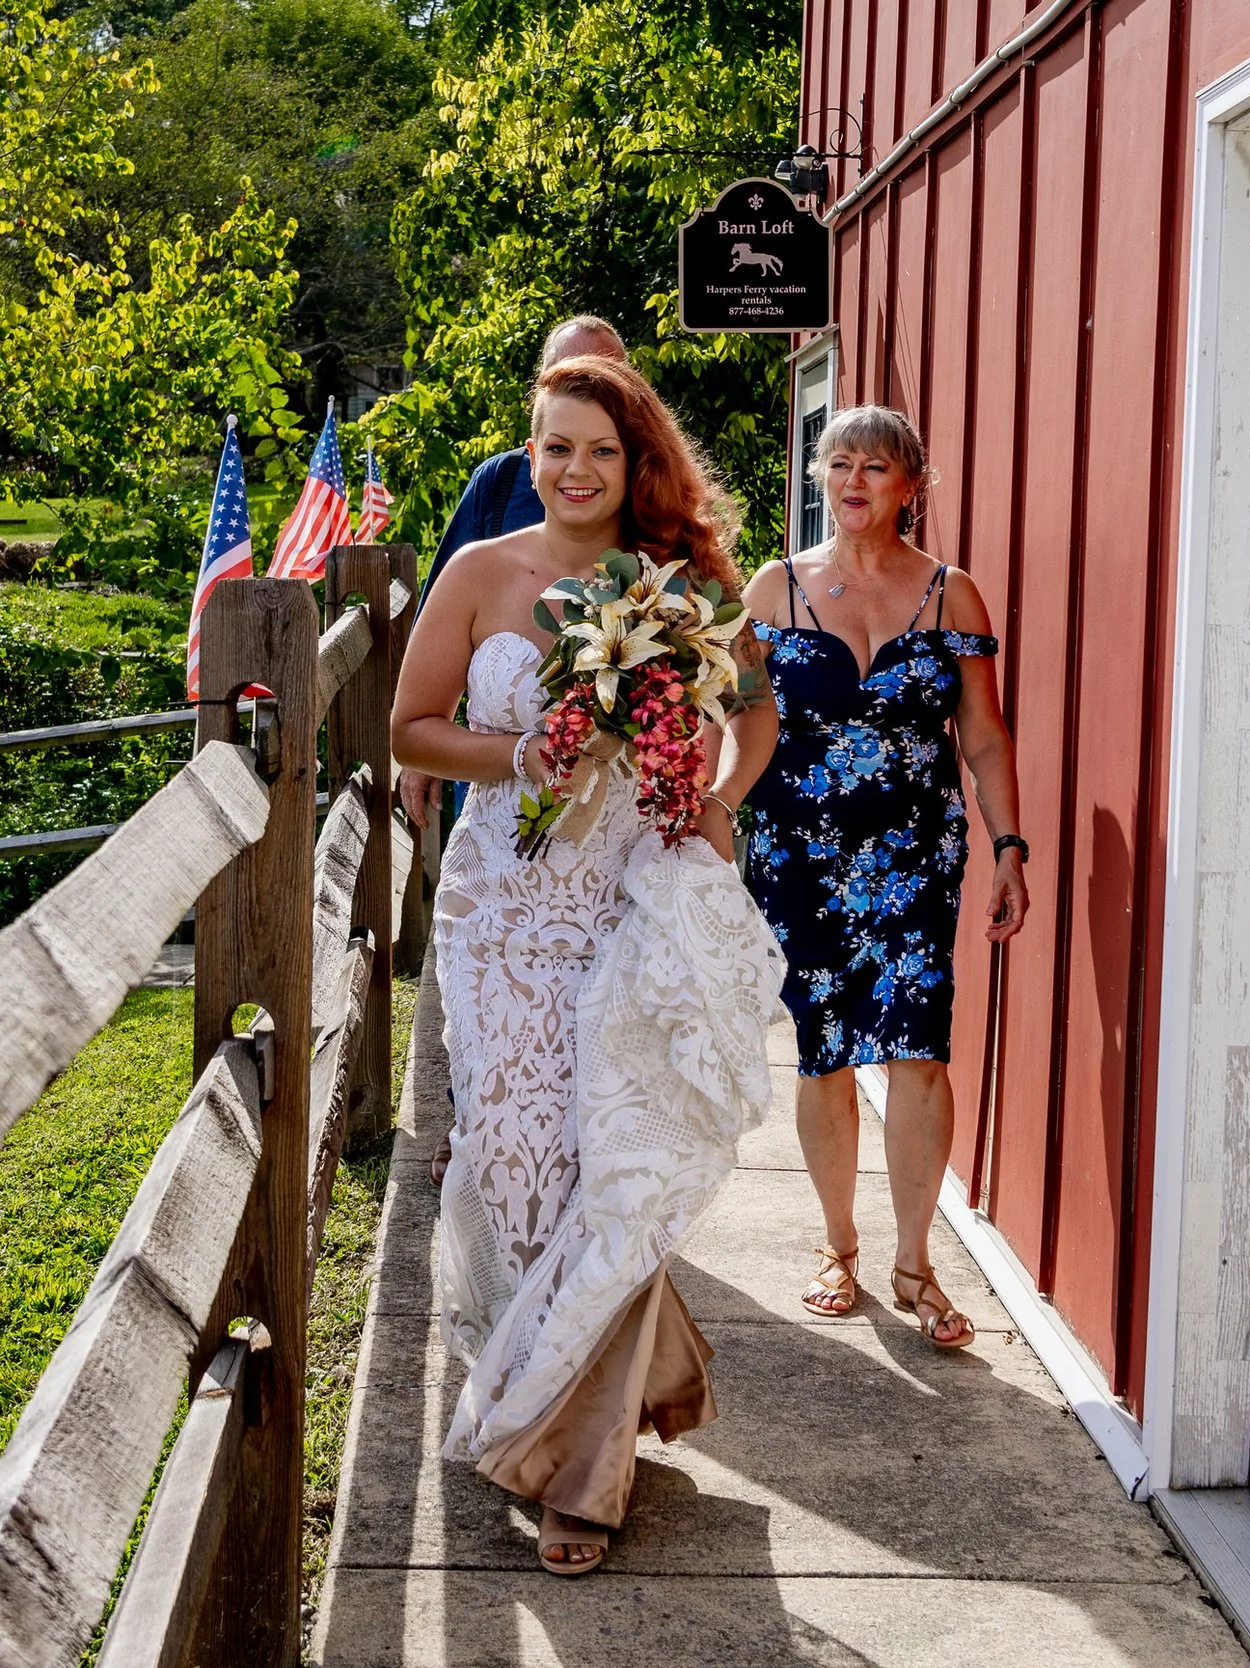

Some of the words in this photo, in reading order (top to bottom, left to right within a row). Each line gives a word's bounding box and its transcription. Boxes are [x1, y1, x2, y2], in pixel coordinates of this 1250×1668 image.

[718, 220, 757, 235] Barn
[761, 219, 795, 235] Loft
[706, 285, 742, 296] Harpers
[743, 285, 768, 296] Ferry
[769, 284, 807, 294] vacation
[741, 296, 772, 305] rentals
[728, 307, 785, 316] 877-468-4236
